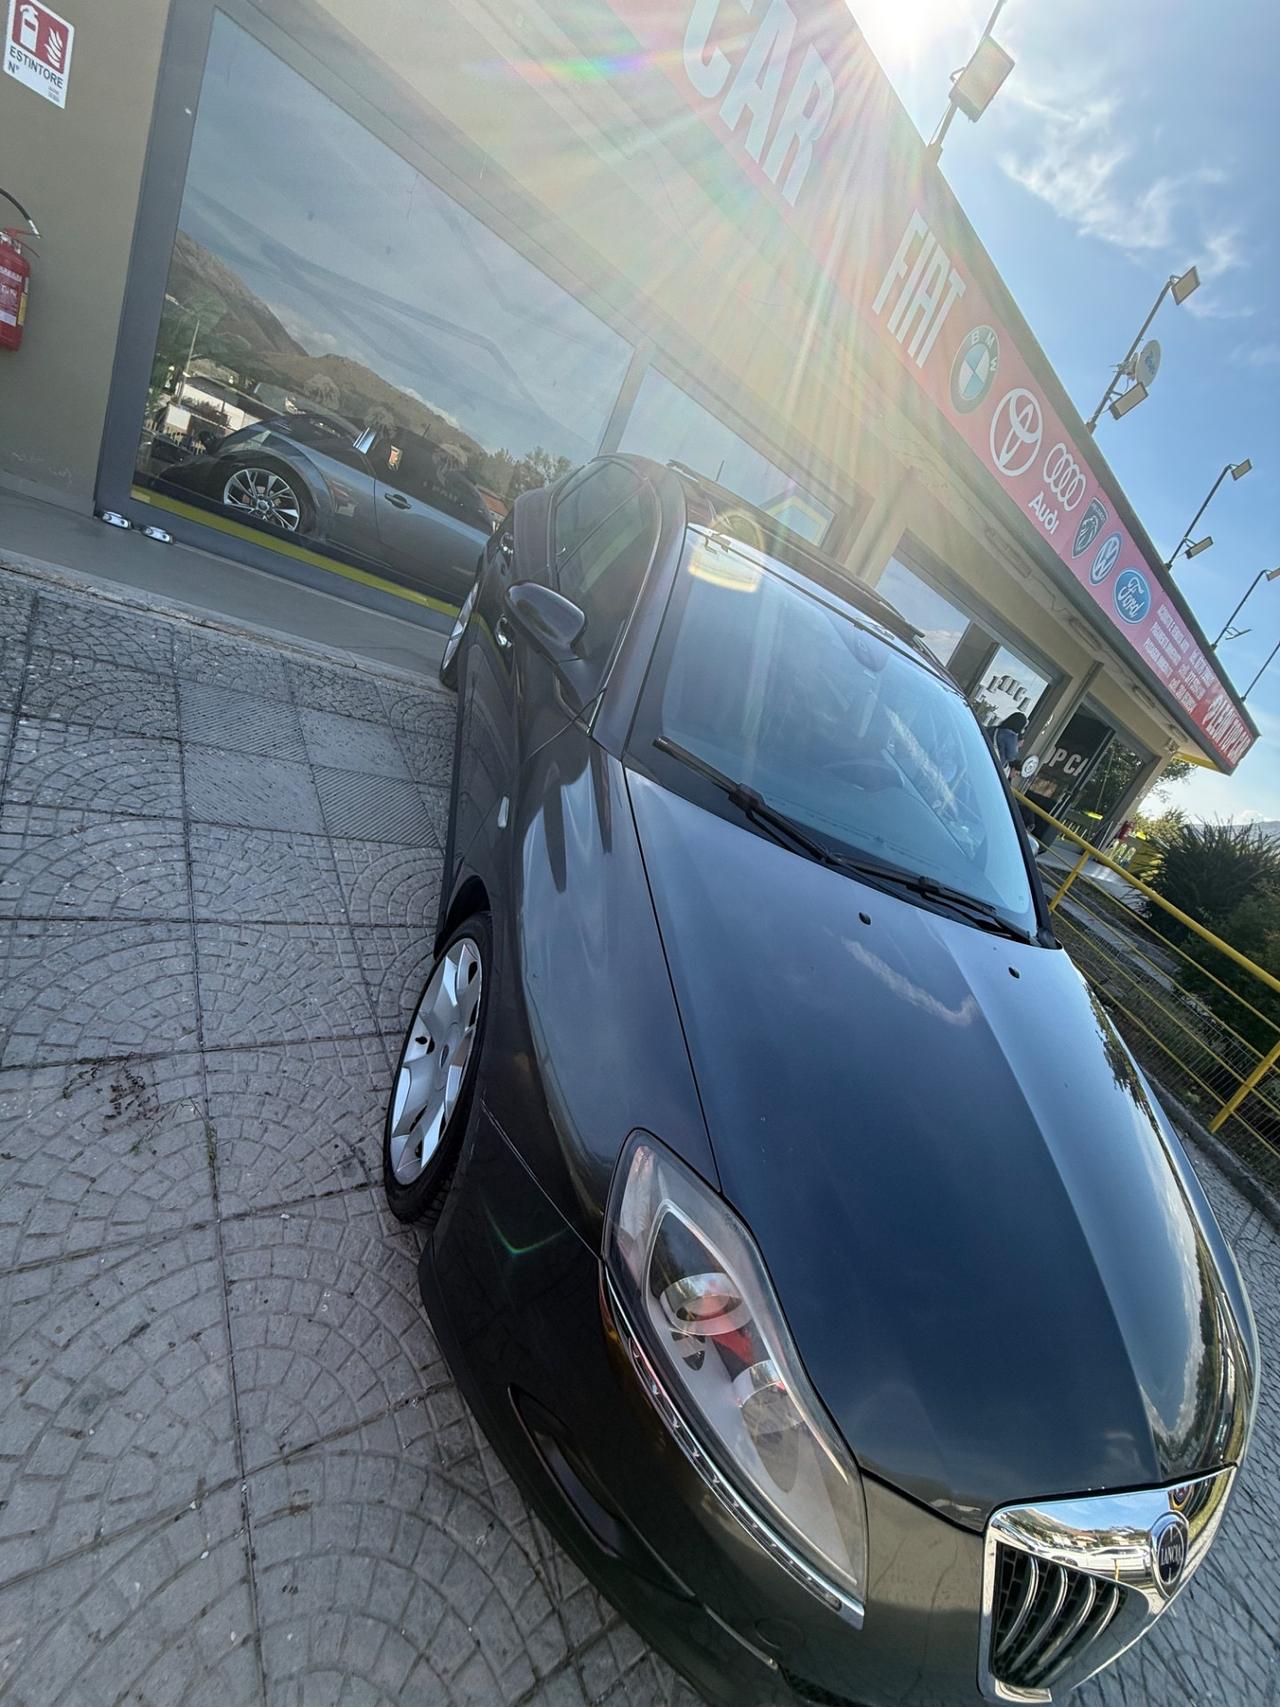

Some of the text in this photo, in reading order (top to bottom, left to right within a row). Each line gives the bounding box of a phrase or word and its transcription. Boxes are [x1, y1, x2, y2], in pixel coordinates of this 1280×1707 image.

[9, 45, 63, 89] ESTINTORE
[682, 0, 834, 207] CAR
[871, 208, 966, 368] FIAT
[971, 330, 999, 373] BMW
[1028, 491, 1059, 534] Audi
[1117, 577, 1144, 618] Ford
